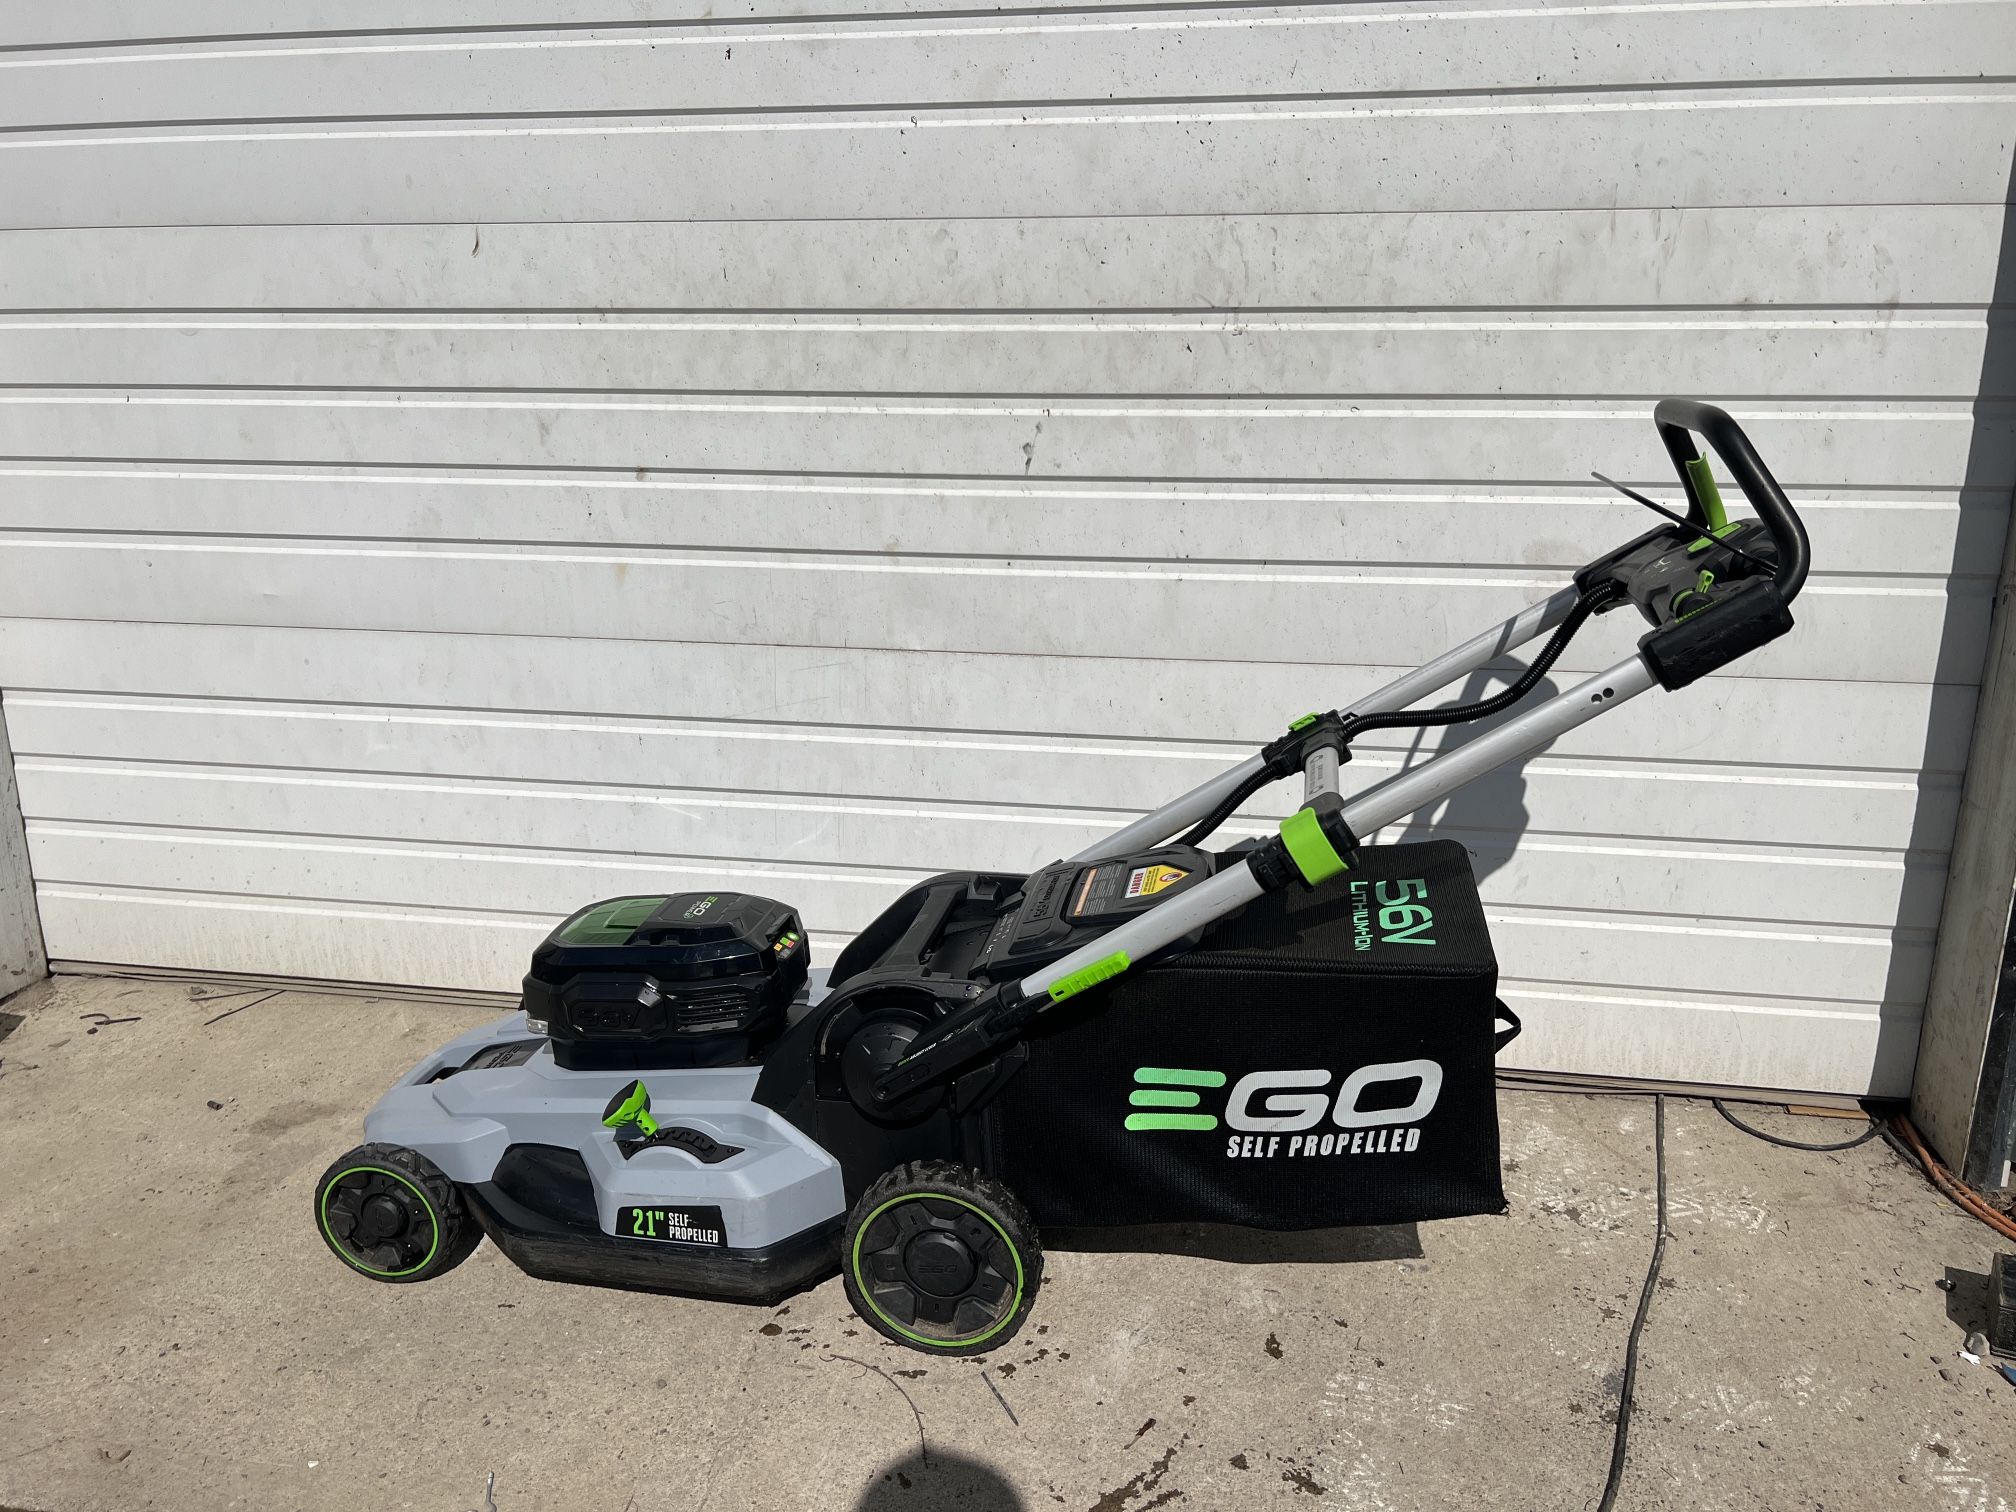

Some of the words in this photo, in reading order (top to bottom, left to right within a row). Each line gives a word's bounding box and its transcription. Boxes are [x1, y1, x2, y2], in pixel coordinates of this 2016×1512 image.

[687, 895, 718, 916] EGO
[1375, 879, 1436, 945] 56V
[1124, 1058, 1444, 1132] EGO
[1226, 1135, 1280, 1158] SELF
[1288, 1128, 1421, 1157] PROPELLED
[632, 1208, 664, 1236] 21"
[669, 1225, 719, 1244] PROPELLED
